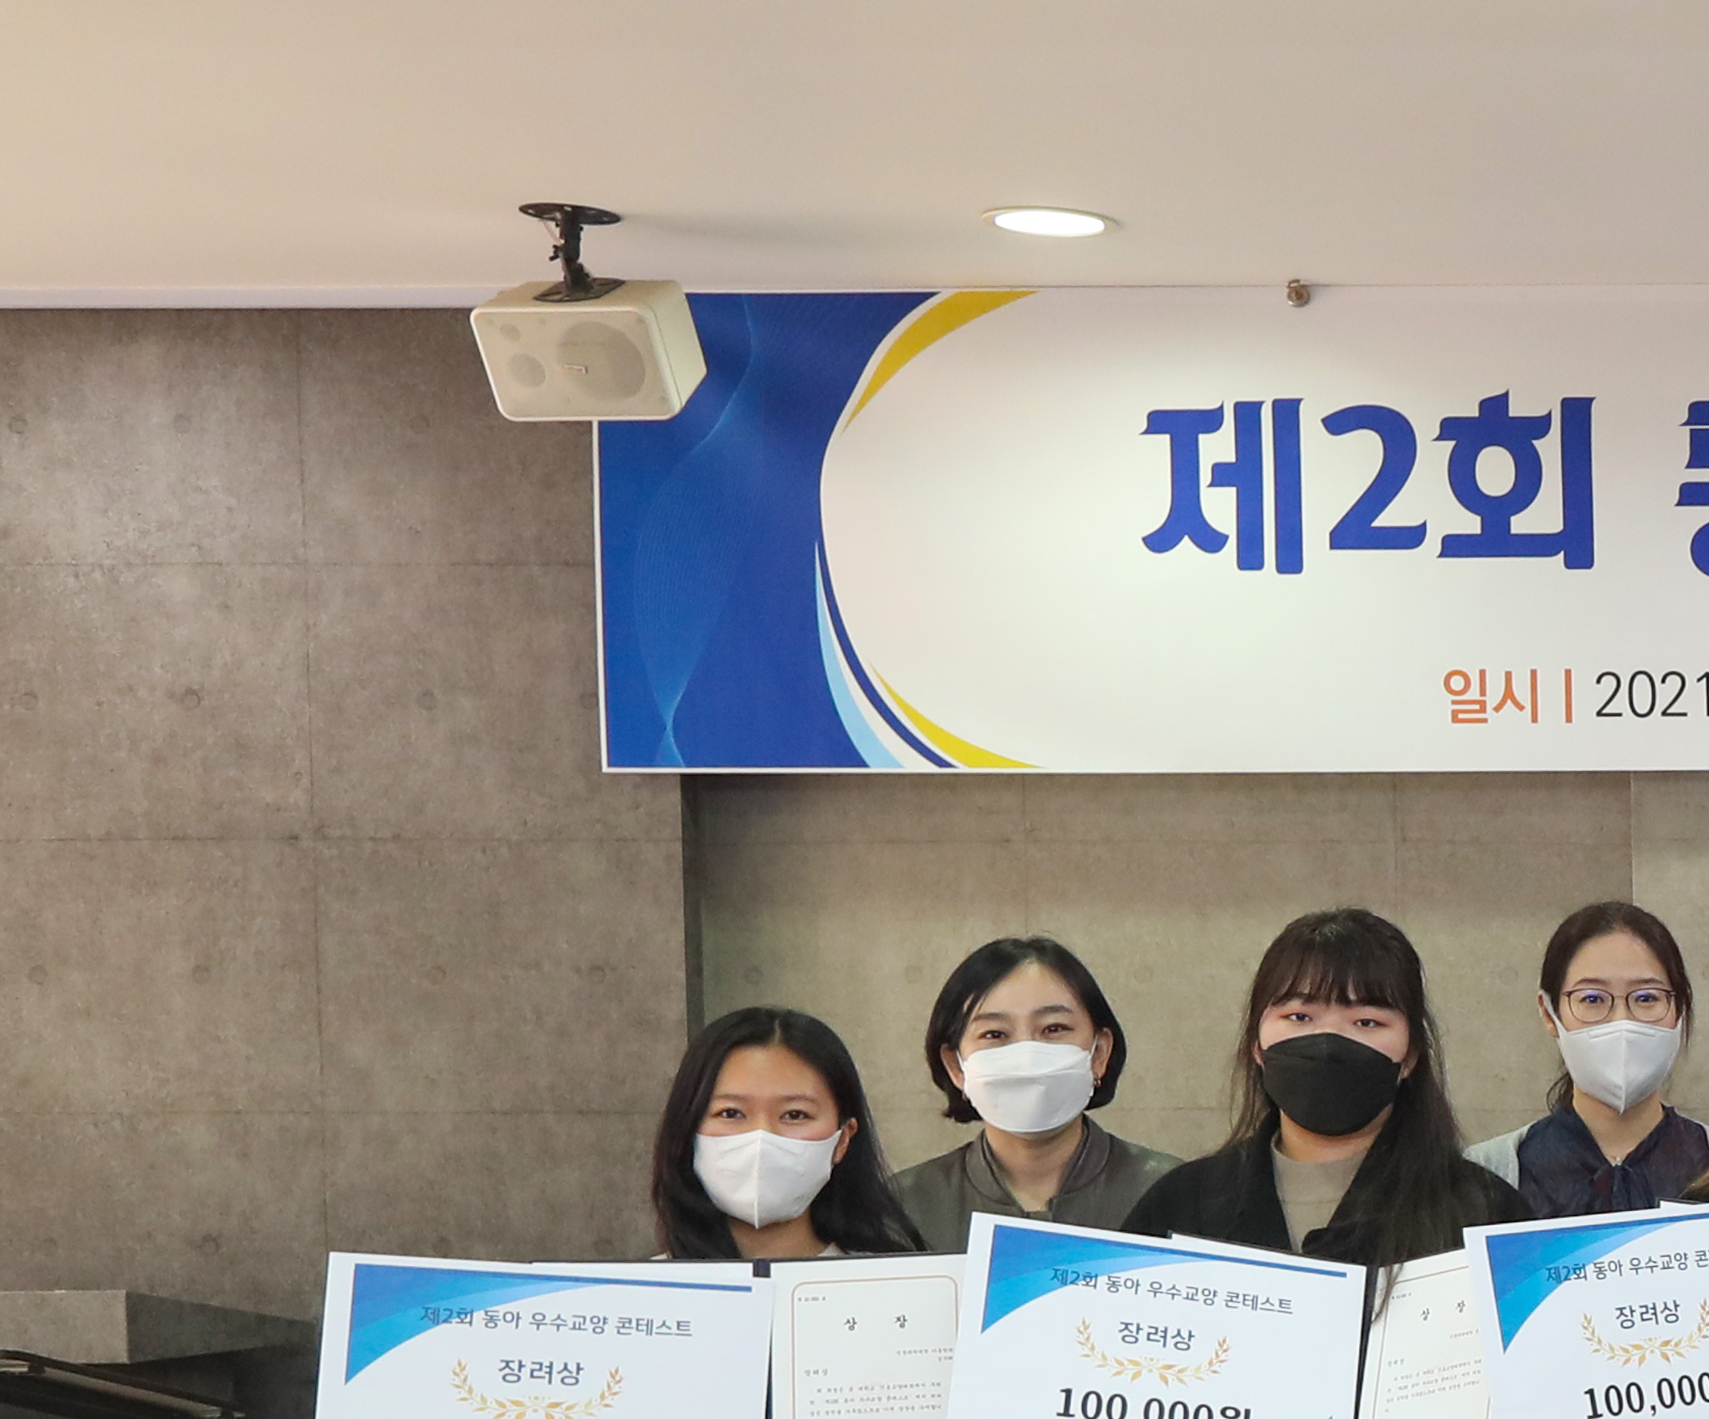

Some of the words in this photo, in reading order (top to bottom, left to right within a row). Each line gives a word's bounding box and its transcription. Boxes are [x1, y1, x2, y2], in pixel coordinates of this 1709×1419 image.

[1140, 388, 1597, 575] 제2회
[1442, 668, 1539, 725] 일시
[1545, 1262, 1588, 1285] 제2회
[1592, 1259, 1624, 1281] 동아
[1628, 1251, 1689, 1276] 우수교양
[1049, 1267, 1099, 1290] 제2회
[1104, 1274, 1142, 1296] 동아
[1146, 1280, 1219, 1307] 우수교양
[1223, 1291, 1294, 1315] 콘테스트
[419, 1306, 474, 1328] 제2회
[481, 1309, 523, 1330] 동아
[528, 1311, 609, 1335] 우수교양
[614, 1316, 693, 1337] 콘테스트
[1614, 1299, 1681, 1330] 장려상
[1117, 1321, 1196, 1352] 장려상
[497, 1358, 585, 1387] 장려상
